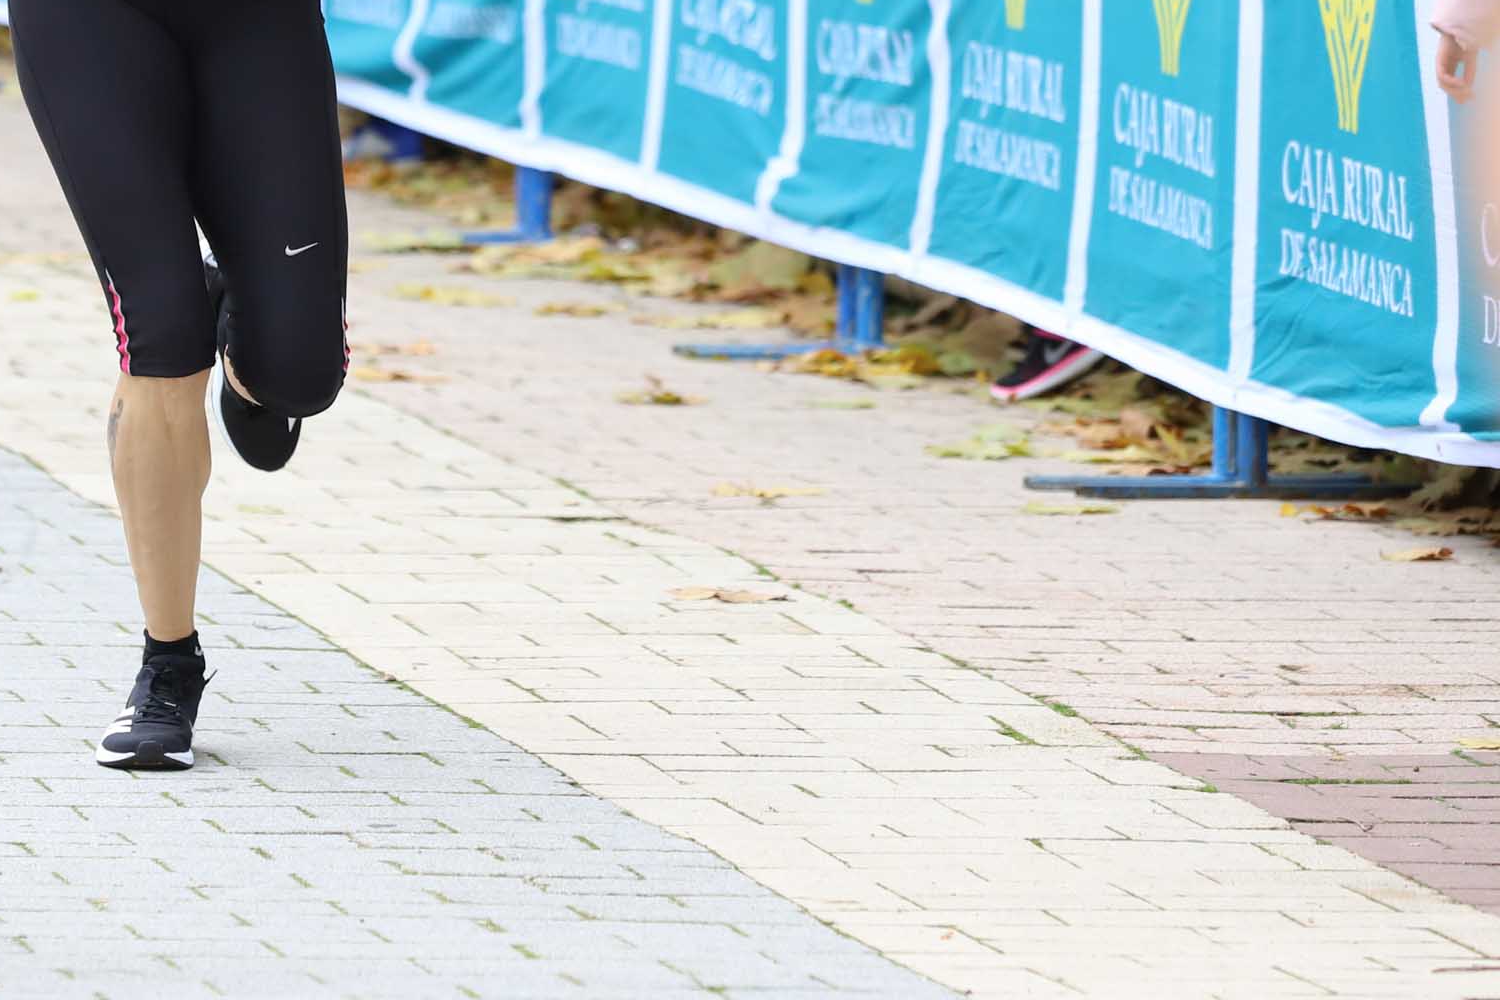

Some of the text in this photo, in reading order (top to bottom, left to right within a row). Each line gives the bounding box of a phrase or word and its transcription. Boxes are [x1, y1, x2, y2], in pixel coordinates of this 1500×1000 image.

[1113, 82, 1216, 178] CAJA RURAL
[1108, 165, 1214, 251] DE SALAMANCA
[1281, 140, 1414, 242] CAJA RURAL
[1279, 227, 1414, 318] DE SALAMANCA
